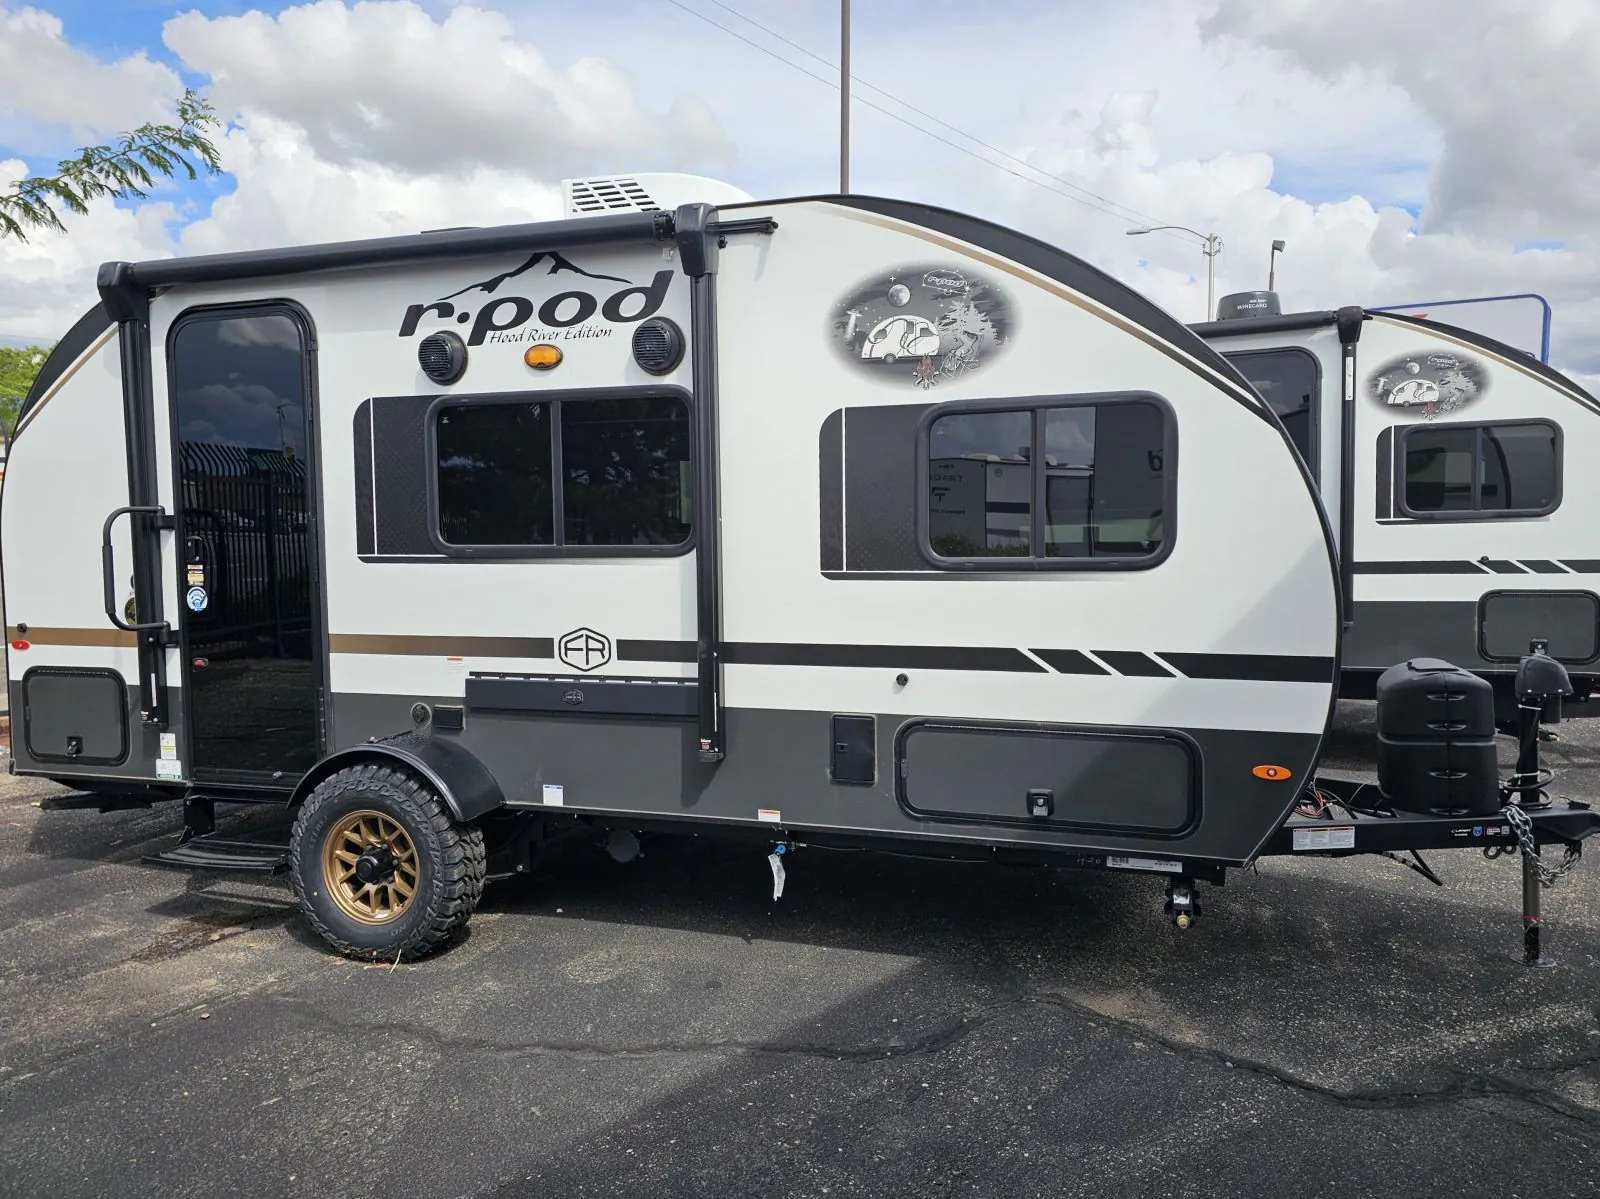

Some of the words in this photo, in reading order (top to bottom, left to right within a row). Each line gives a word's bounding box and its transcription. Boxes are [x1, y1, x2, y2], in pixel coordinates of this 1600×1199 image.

[489, 327, 526, 344] Hood
[527, 328, 562, 342] River
[564, 324, 613, 341] Edition
